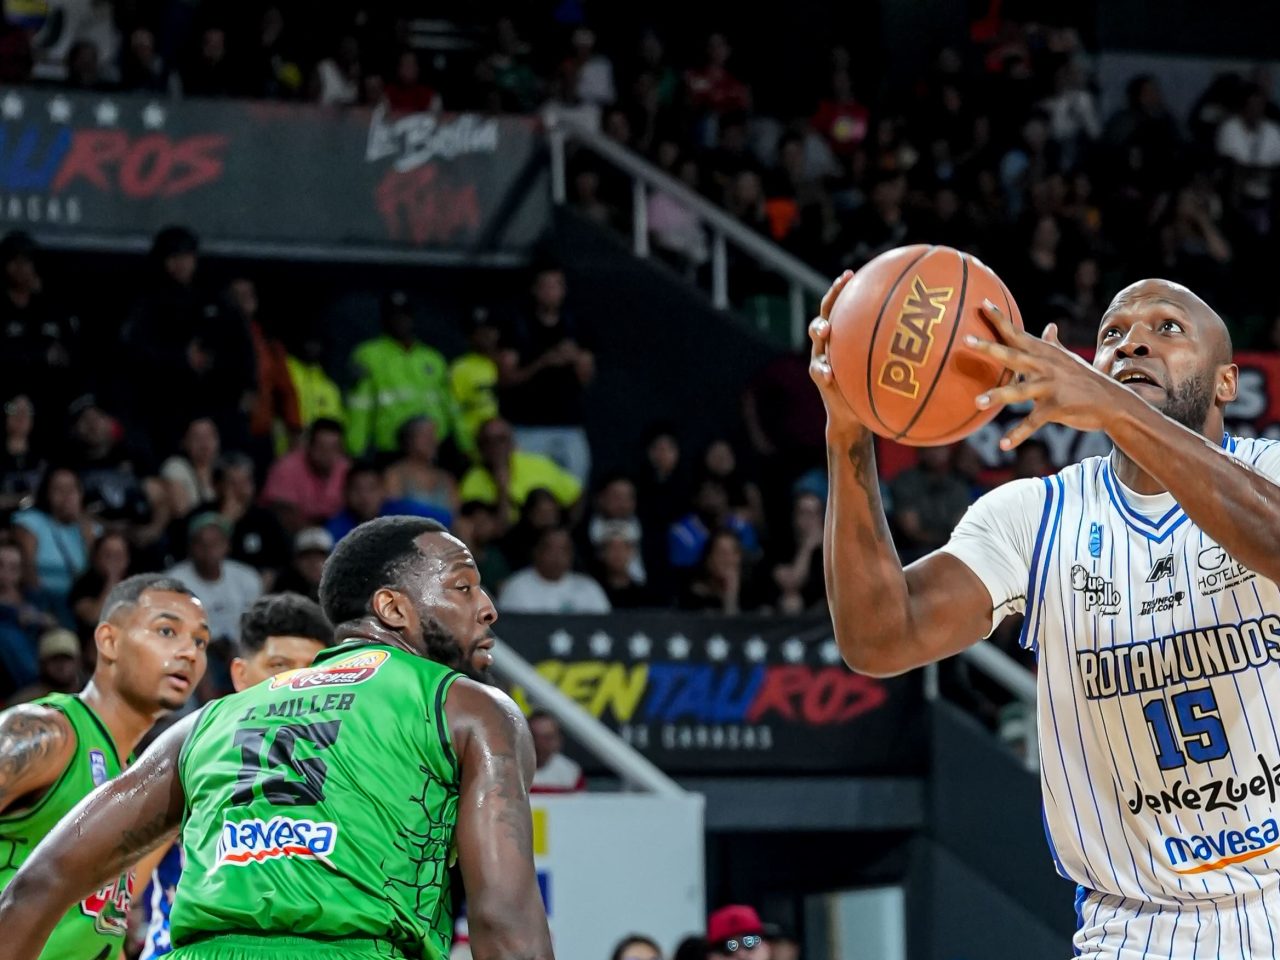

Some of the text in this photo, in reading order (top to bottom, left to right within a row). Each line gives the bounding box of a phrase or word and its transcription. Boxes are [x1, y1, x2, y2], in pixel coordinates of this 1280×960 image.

[0, 124, 232, 198] UROS
[879, 274, 953, 399] PEAK
[1085, 582, 1121, 611] pollo
[1198, 564, 1248, 590] HOTELE
[239, 692, 356, 721] J. MILLER
[1142, 686, 1231, 771] 15
[229, 719, 342, 806] 15
[1164, 818, 1280, 866] mavesa
